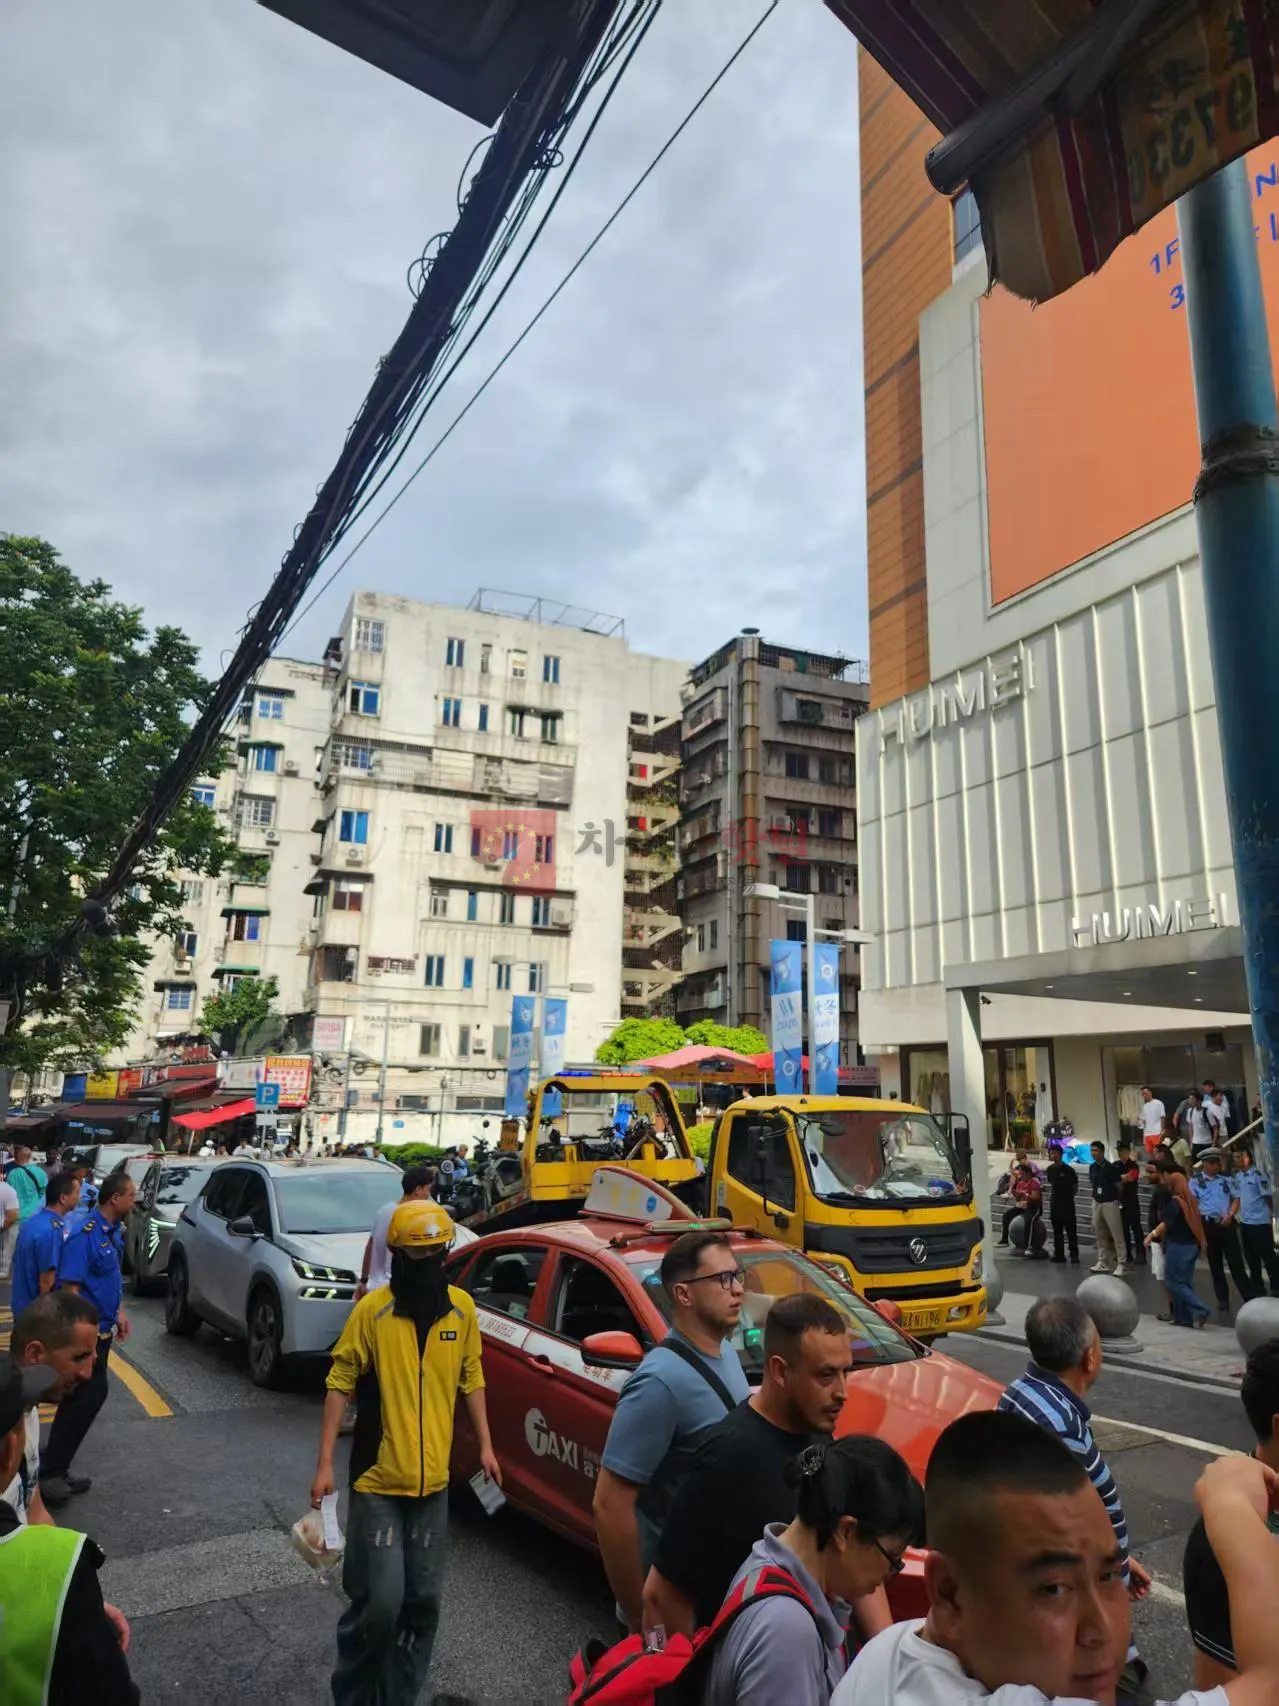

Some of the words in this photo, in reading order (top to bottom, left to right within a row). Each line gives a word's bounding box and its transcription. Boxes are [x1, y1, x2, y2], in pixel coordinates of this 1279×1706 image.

[879, 647, 1037, 754] HUIMEI
[1071, 892, 1228, 948] HUIMEI
[262, 1087, 274, 1103] P
[528, 1412, 580, 1470] TAXI
